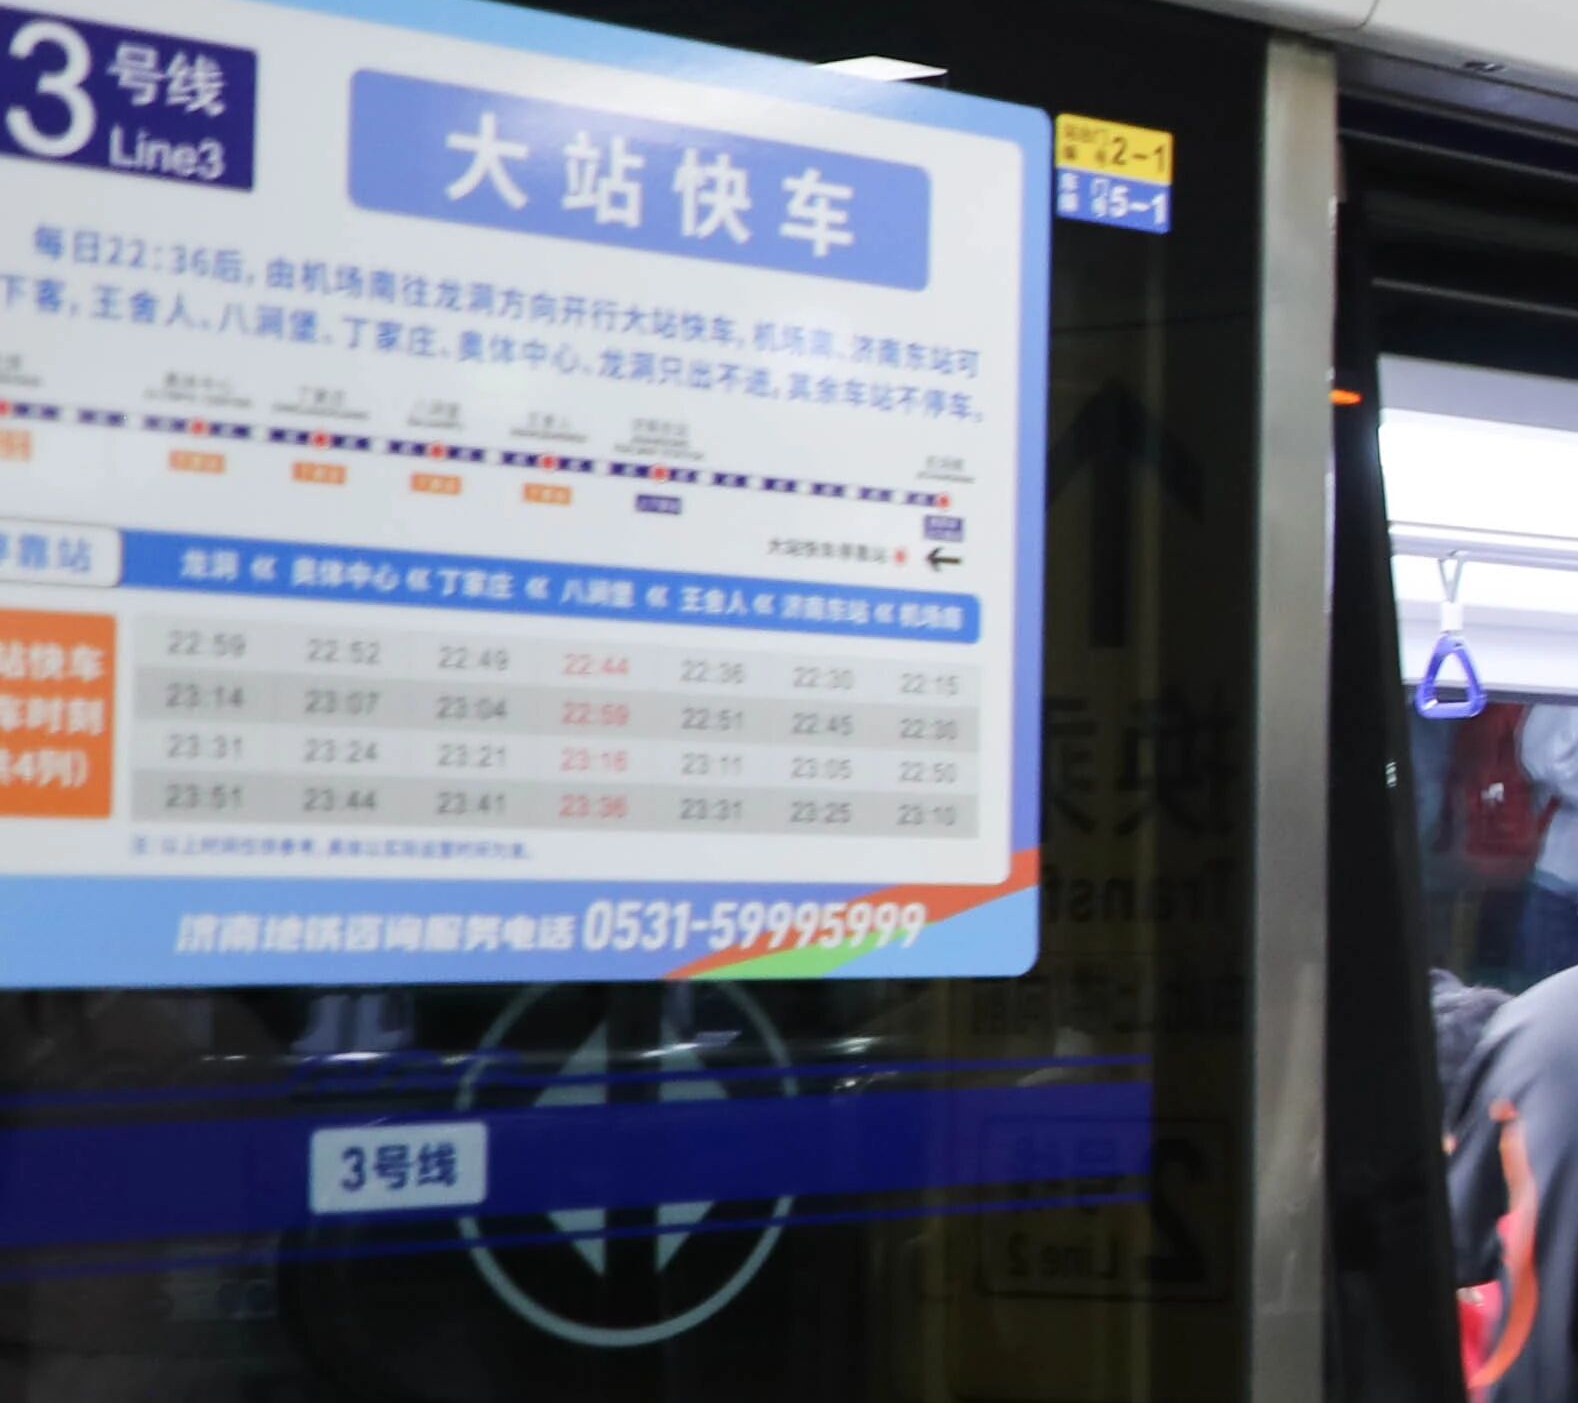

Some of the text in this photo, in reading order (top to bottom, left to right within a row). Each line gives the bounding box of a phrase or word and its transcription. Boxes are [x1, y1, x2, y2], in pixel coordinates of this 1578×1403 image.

[5, 18, 97, 159] 3
[107, 42, 227, 117] 号线
[109, 124, 226, 180] Line3
[445, 112, 856, 259] 大站快车
[0, 534, 92, 574] 靠站
[583, 899, 928, 952] 0531-59995999
[341, 1141, 458, 1191] 3号线
